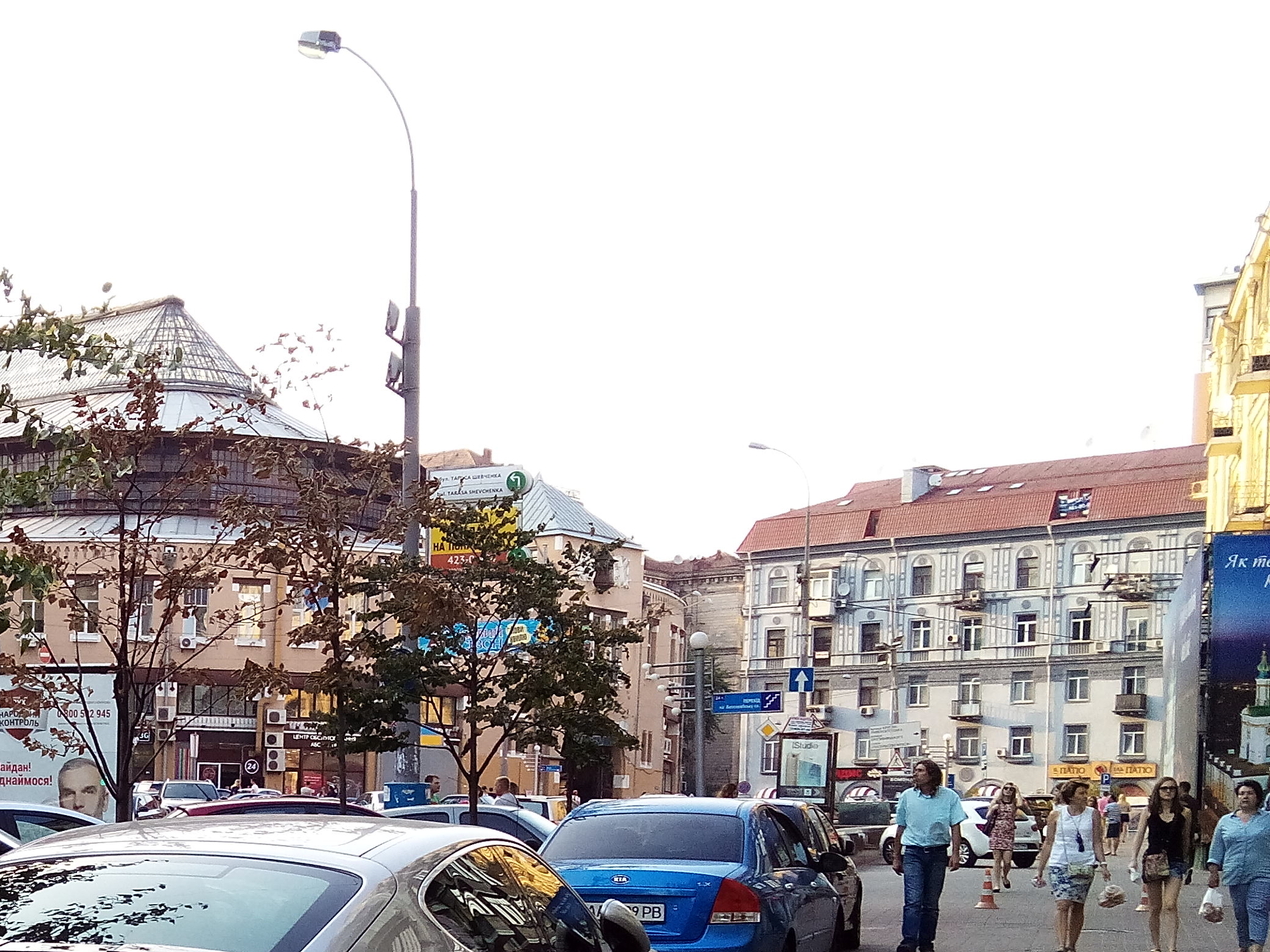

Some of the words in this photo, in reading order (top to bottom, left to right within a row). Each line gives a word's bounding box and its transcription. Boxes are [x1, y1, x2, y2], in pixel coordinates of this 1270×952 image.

[1224, 554, 1248, 568] Як
[80, 709, 94, 718] 52
[96, 709, 111, 718] 945
[0, 719, 39, 727] КОНТРОЛЬ
[247, 763, 257, 771] 24
[642, 906, 662, 919] PB
